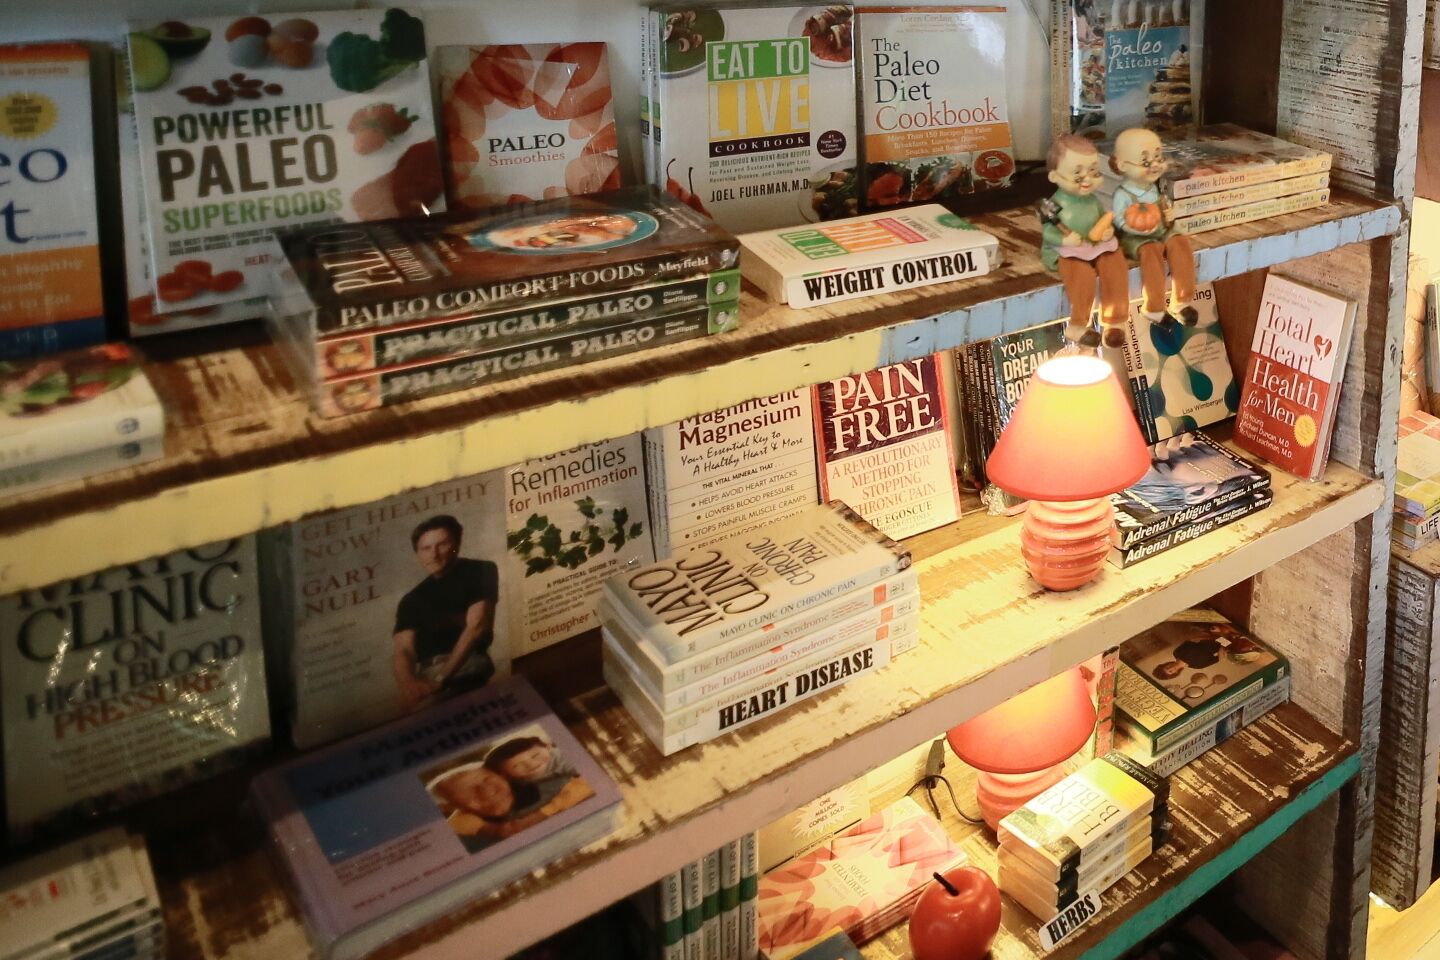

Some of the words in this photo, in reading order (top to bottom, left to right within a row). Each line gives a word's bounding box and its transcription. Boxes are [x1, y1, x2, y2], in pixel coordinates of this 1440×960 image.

[712, 43, 759, 80] EAT
[771, 40, 804, 75] TO
[872, 38, 900, 52] The
[873, 50, 940, 78] Paleo
[1116, 56, 1167, 70] kitchen
[709, 79, 810, 138] LIVE
[874, 79, 932, 103] Diet
[153, 103, 334, 146] POWERFUL
[876, 97, 1000, 130] Cookbook
[488, 133, 566, 153] PALEO
[488, 150, 566, 167] Smoothies
[715, 136, 805, 153] COOKBOOK
[157, 134, 338, 202] PALEO
[1185, 181, 1210, 194] paleo
[1212, 174, 1245, 187] kitchen
[162, 188, 343, 234] SUPERFOODS
[710, 189, 735, 203] JOEL
[739, 181, 791, 198] FUHRMAN,
[792, 178, 812, 191] M.D.
[1187, 218, 1211, 232] paleo
[1214, 211, 1246, 225] kitchen
[340, 295, 429, 327] PALEO
[436, 277, 561, 311] COMFORT
[570, 263, 645, 289] FOODS
[658, 255, 709, 273] Mayfield
[803, 267, 884, 301] WEIGHT
[892, 252, 977, 285] CONTROL
[383, 312, 556, 359] PRACTICAL
[568, 294, 653, 324] PALEO
[1266, 301, 1313, 344] Total
[389, 346, 560, 395] PRACTICAL
[570, 326, 655, 358] PALEO
[1001, 338, 1034, 358] YOUR
[1258, 330, 1315, 376] Heart
[1252, 358, 1320, 412] Health
[679, 404, 801, 451] Magnesium
[829, 394, 935, 455] FREE
[1243, 391, 1263, 408] for
[1263, 393, 1295, 426] Men
[510, 446, 626, 495] Remedies
[832, 466, 841, 478] A
[843, 437, 943, 473] REVOLUTIONARY
[851, 463, 904, 488] METHOD
[907, 454, 931, 471] FOR
[509, 498, 533, 514] for
[538, 464, 638, 506] Inflammation
[699, 494, 720, 507] HELPS
[721, 486, 745, 501] AVOID
[745, 478, 767, 491] HEART
[768, 469, 798, 484] ATTACKS
[705, 506, 735, 519] LOWERS
[736, 496, 761, 510] BLOOD
[762, 483, 795, 500] PRESSURE
[862, 473, 921, 501] STOPPING
[302, 511, 353, 542] GET
[366, 478, 495, 526] HEALTHY
[693, 525, 717, 538] STOPS
[718, 515, 747, 531] PAINFUL
[748, 504, 777, 521] MUSCLE
[778, 494, 807, 510] CRAMPS
[1124, 518, 1171, 546] Adrenal
[1172, 502, 1211, 526] Fatigue
[1421, 518, 1439, 535] LIFE
[1125, 534, 1171, 563] Adrenal
[1174, 521, 1213, 544] Fatigue
[301, 563, 382, 598] GARY
[15, 561, 245, 664] CLINIC
[303, 585, 382, 619] NULL
[111, 634, 167, 665] ON
[692, 658, 712, 675] The
[714, 633, 788, 665] Inflammation
[783, 614, 829, 637] Syndrome
[24, 666, 121, 721] HIGH
[126, 633, 245, 689] BLOOD
[718, 682, 790, 731] HEART
[795, 647, 874, 698] DISEASE
[815, 802, 837, 817] MILLION
[819, 798, 831, 807] ONE
[1047, 893, 1095, 945] HERBS
